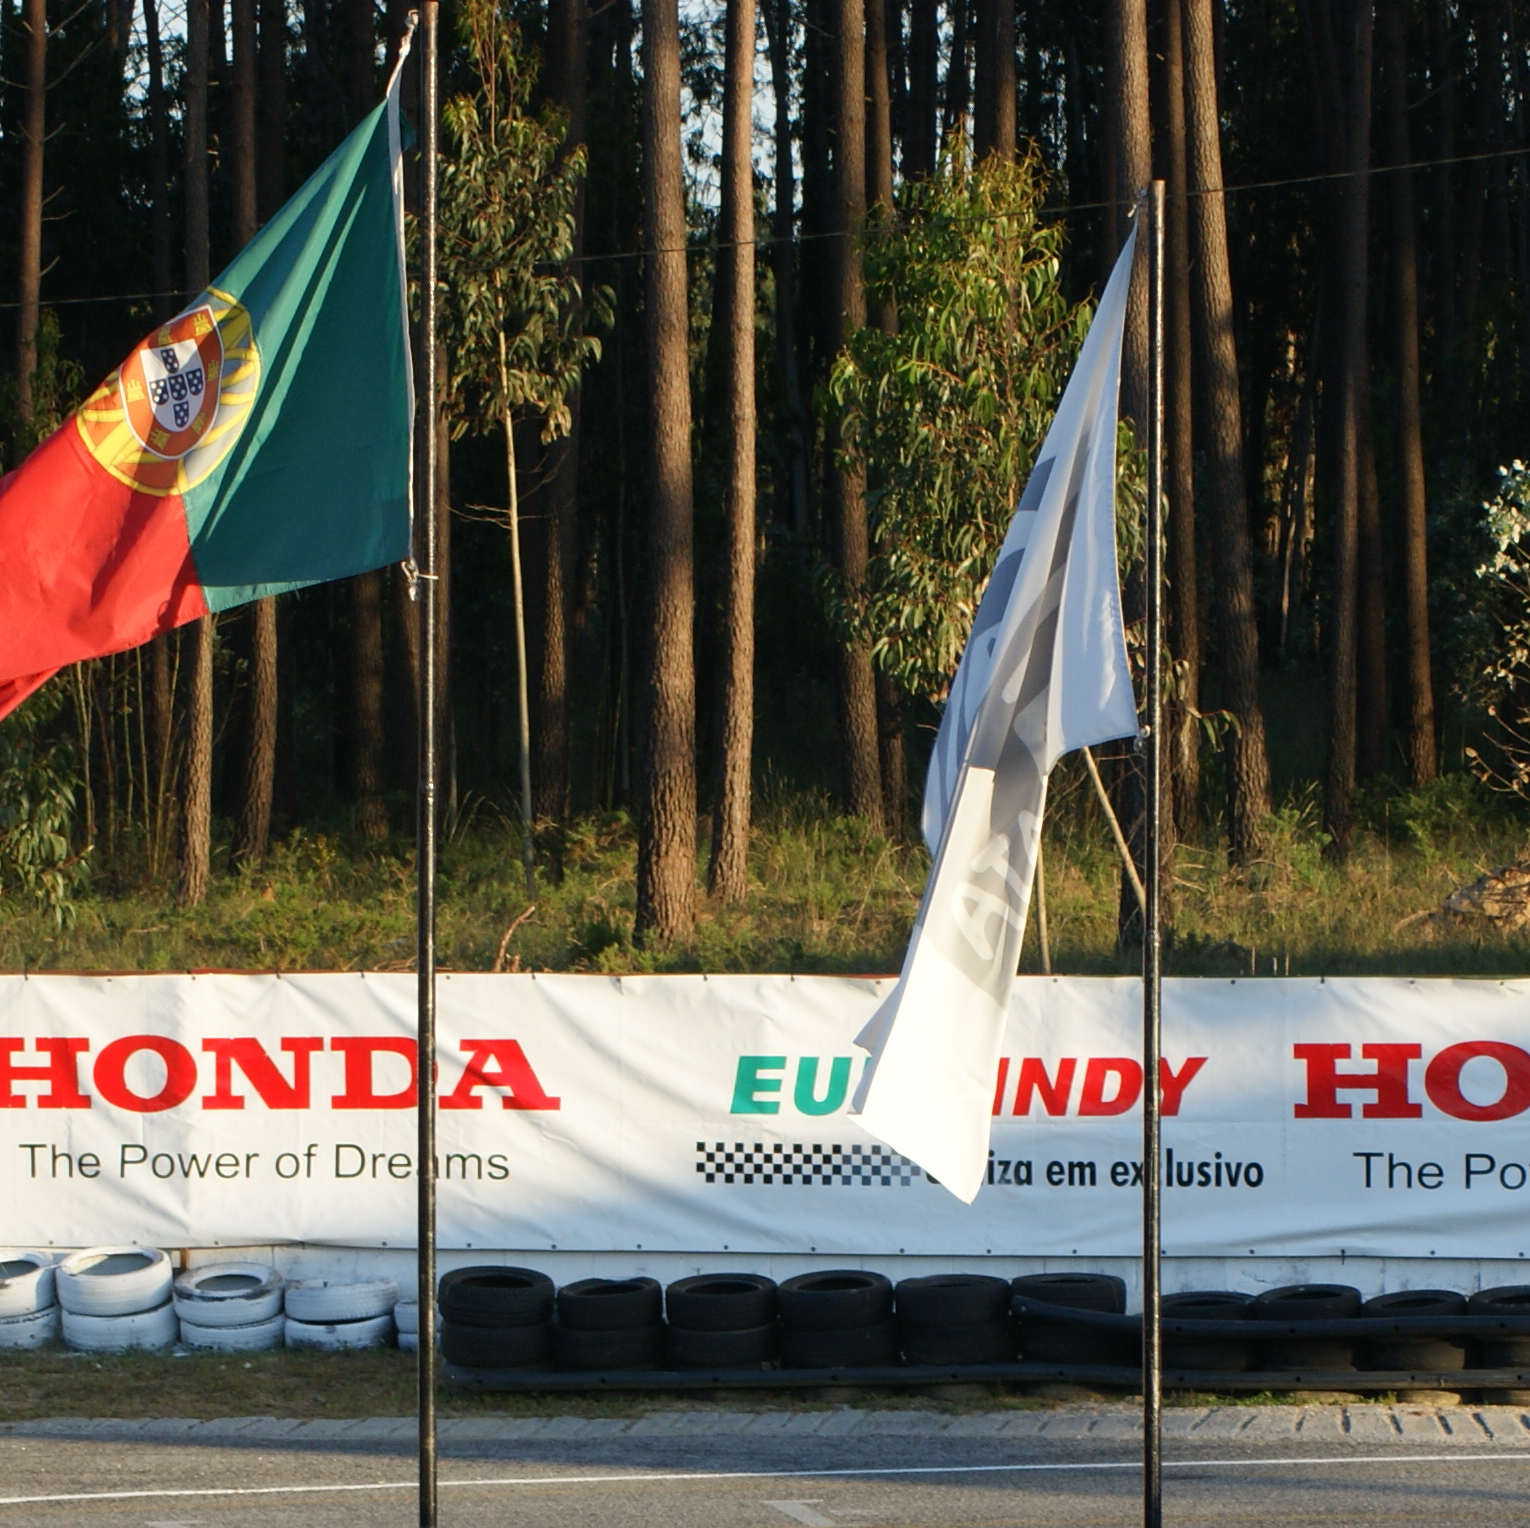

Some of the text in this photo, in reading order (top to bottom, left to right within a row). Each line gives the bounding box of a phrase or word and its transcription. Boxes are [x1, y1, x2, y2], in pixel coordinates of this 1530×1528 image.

[729, 1055, 1210, 1117] EUINDY
[18, 1143, 102, 1179] The
[119, 1143, 260, 1179] Power
[274, 1142, 317, 1179] of
[1045, 1159, 1098, 1187] em
[1109, 1147, 1265, 1188] exlusivo
[1352, 1151, 1445, 1190] The
